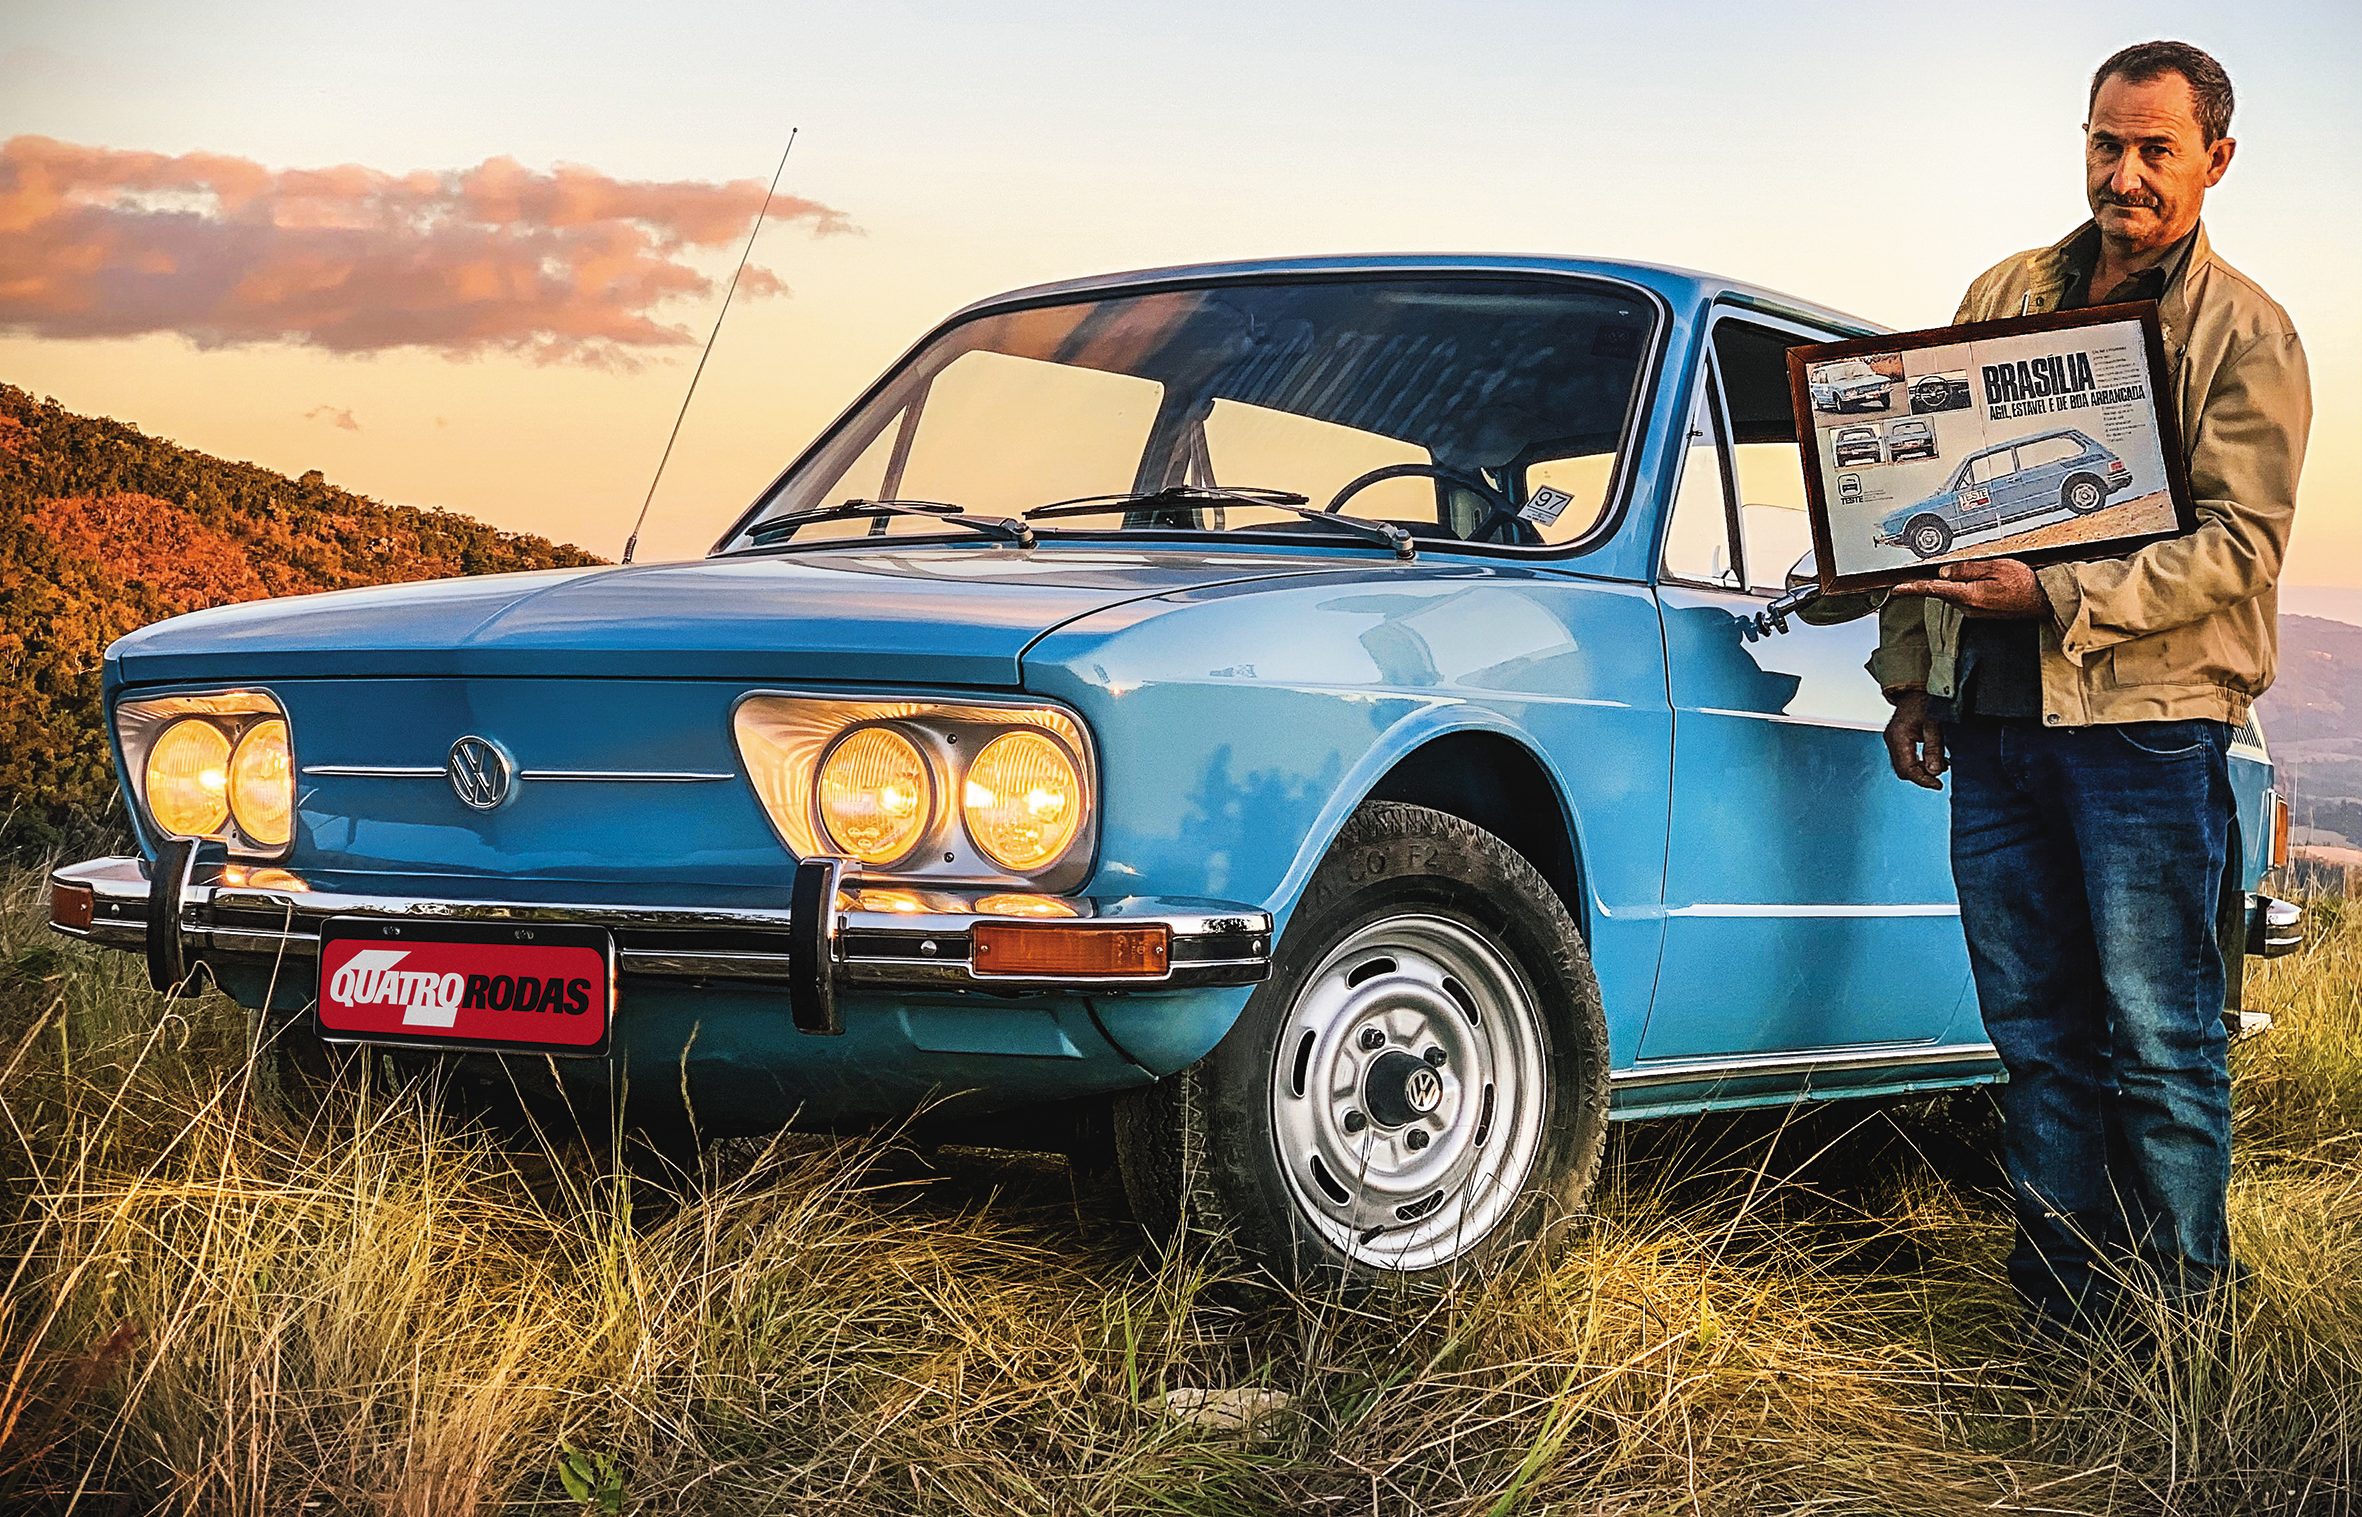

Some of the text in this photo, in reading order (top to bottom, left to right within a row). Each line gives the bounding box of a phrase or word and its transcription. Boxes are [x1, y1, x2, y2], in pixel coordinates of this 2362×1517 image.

[1982, 351, 2096, 405] BRASÍLIA
[2048, 398, 2055, 412] E
[2056, 396, 2068, 411] DE
[2070, 392, 2089, 409] BOA
[2091, 385, 2146, 406] ARRANCADA
[1534, 491, 1567, 511] 97
[1840, 495, 1864, 506] TESTE
[1961, 488, 1987, 502] TESTE
[1408, 1070, 1440, 1112] VW
